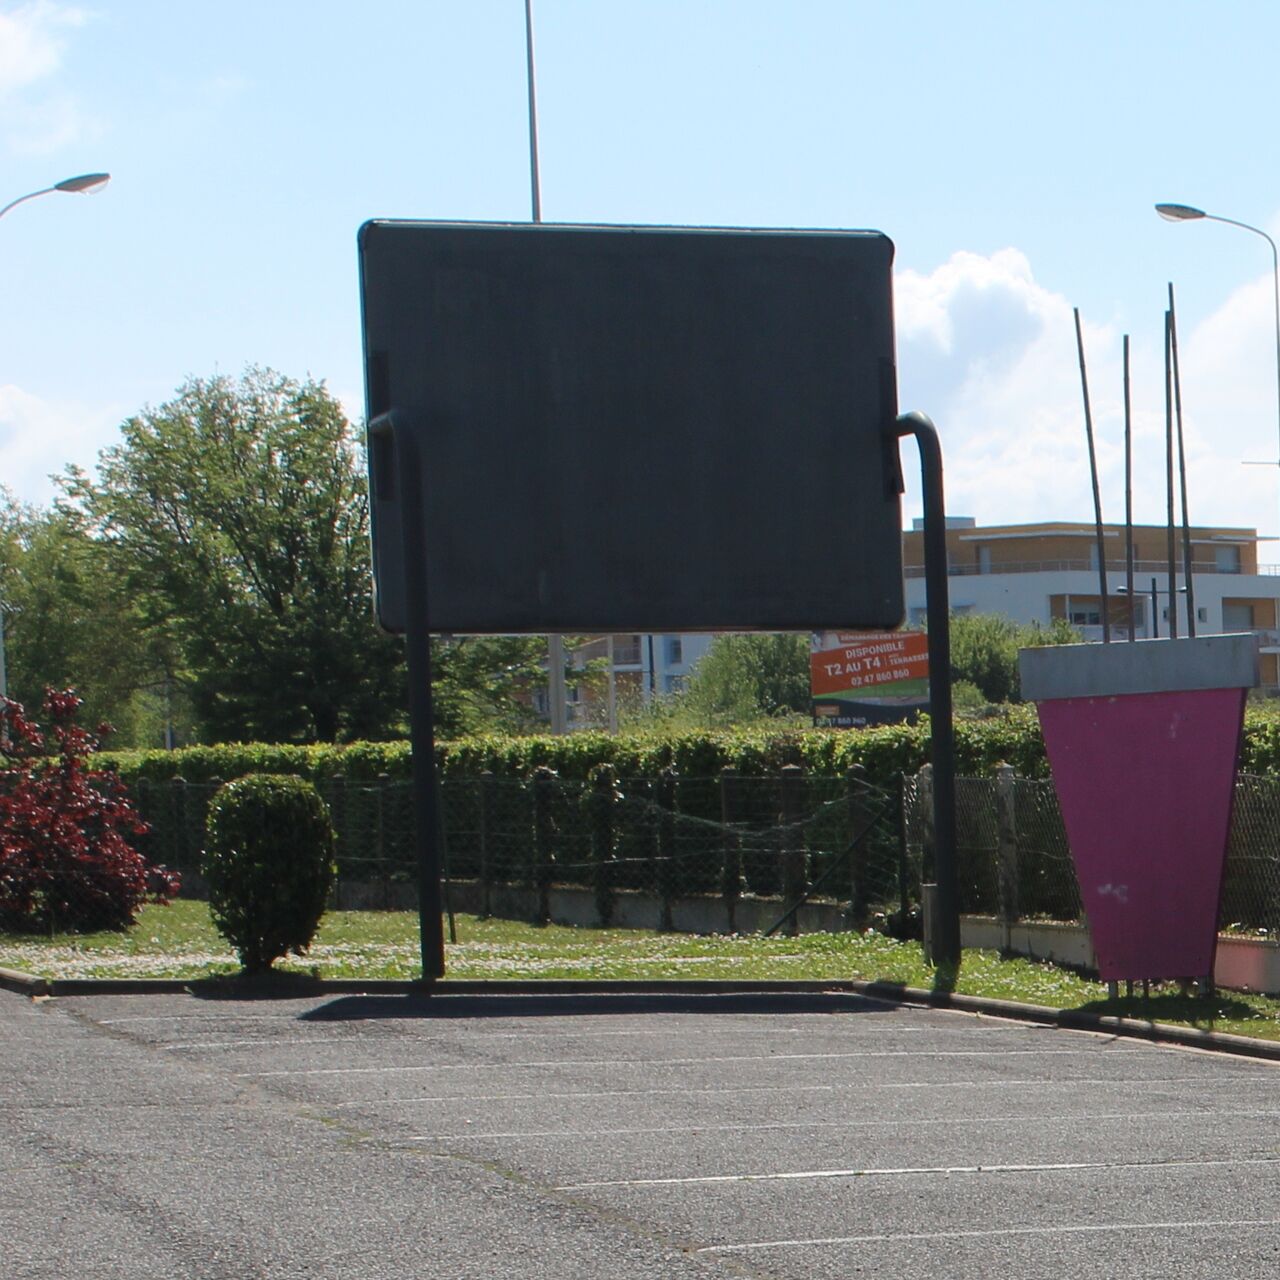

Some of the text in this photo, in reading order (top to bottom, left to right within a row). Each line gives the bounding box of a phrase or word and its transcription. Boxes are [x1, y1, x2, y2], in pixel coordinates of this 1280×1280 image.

[846, 641, 904, 658] DISPONIBLE
[825, 657, 880, 676] T2 AU T4
[851, 677, 862, 685] 02
[864, 674, 874, 682] 47
